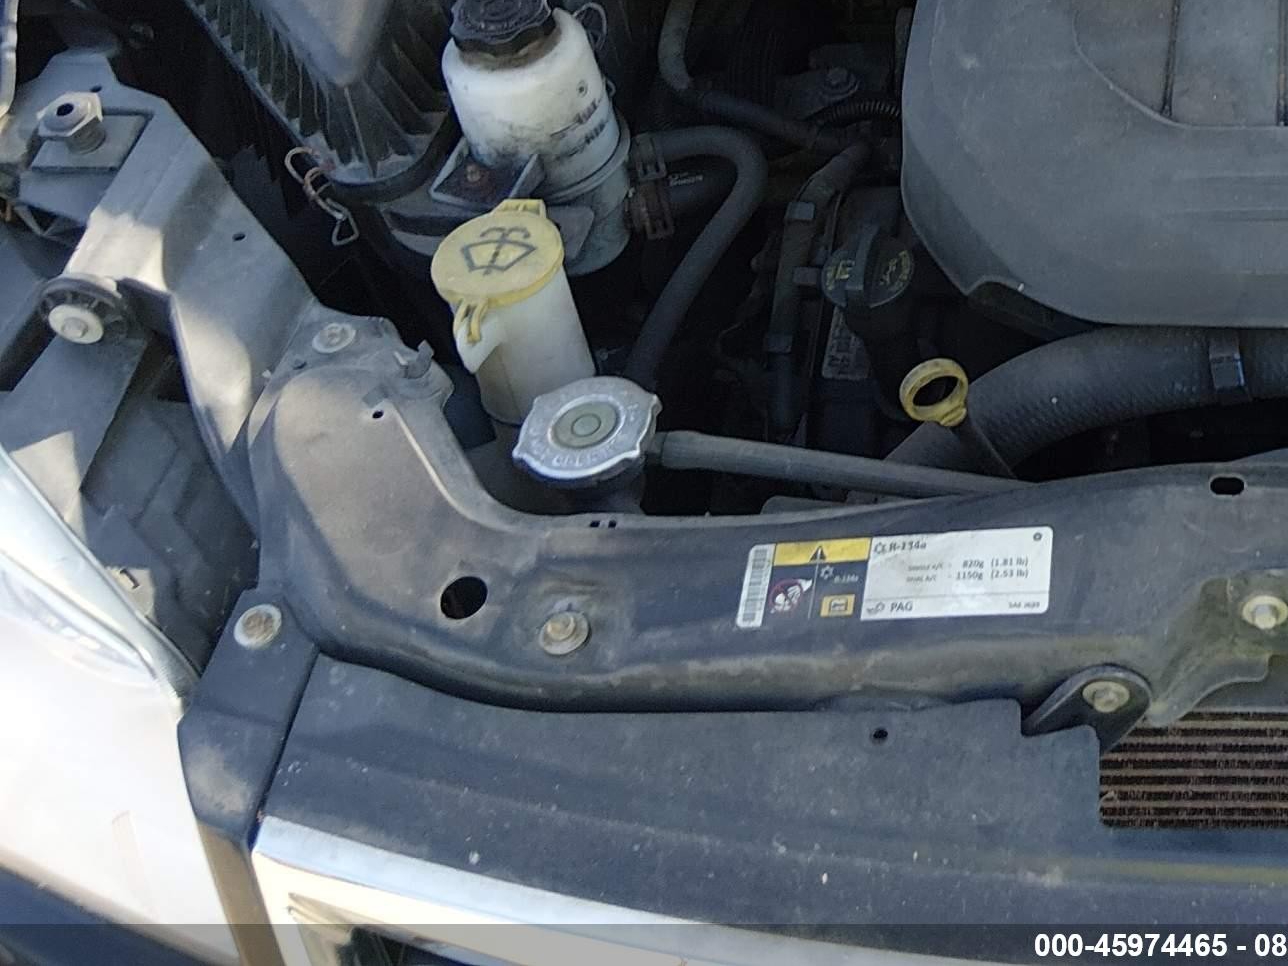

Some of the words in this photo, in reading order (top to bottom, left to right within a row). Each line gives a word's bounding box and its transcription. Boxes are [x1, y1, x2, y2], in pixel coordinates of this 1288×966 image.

[962, 559, 984, 569] 820g
[991, 557, 1013, 568] (1.81
[1016, 556, 1029, 567] lb)
[956, 570, 983, 581] 1150g
[991, 569, 1014, 580] (2.53
[1016, 568, 1029, 579] lb)
[890, 601, 913, 612] PAG
